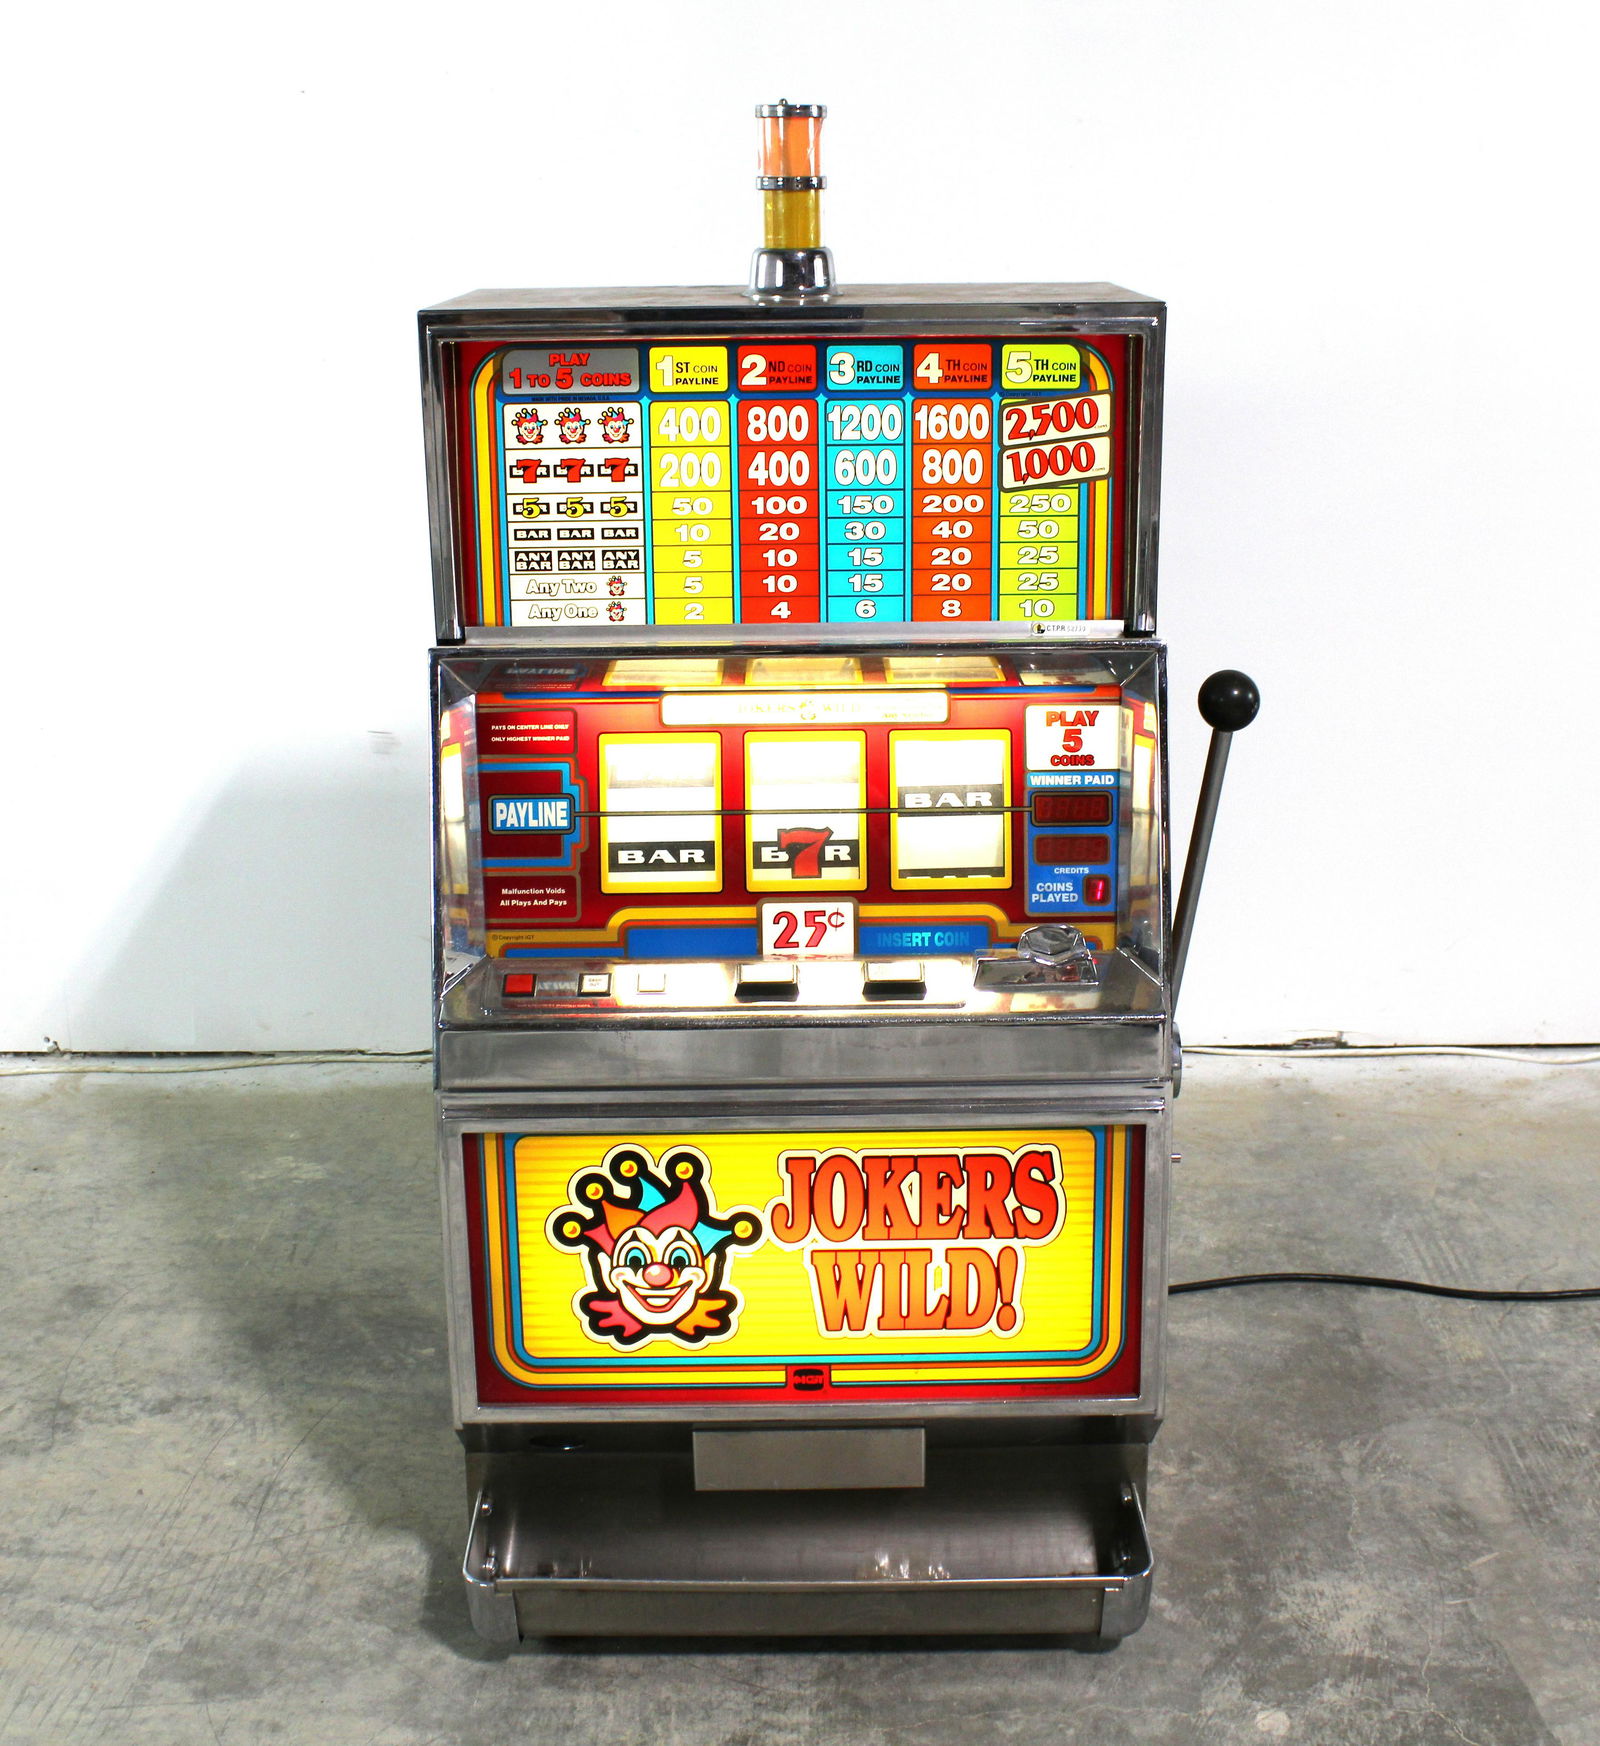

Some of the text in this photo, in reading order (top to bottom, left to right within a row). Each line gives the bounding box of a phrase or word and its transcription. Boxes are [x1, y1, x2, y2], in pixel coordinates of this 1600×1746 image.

[549, 353, 590, 367] PLAY
[875, 363, 900, 372] COIN
[963, 363, 988, 372] COIN
[1051, 362, 1077, 371] COIN
[693, 365, 718, 373] COIN
[787, 364, 813, 373] COIN
[509, 368, 632, 389] 1 TO 5 COINS
[675, 377, 719, 386] PAYLINE
[768, 375, 813, 385] PAYLINE
[856, 374, 901, 384] PAYLINE
[944, 373, 988, 384] PAYLINE
[1032, 373, 1077, 383] PAYLINE
[658, 398, 1100, 443] 400 800 1200 1600 2,500
[659, 441, 1096, 489] 200 400 600 800 1,000
[672, 493, 1072, 515] 50 100 150 200 250
[516, 529, 637, 539] BAR BAR BAR
[675, 520, 1060, 542] 10 20 30 40 50
[516, 551, 638, 561] ANY ANY ANY
[682, 546, 1059, 568] 5 10 15 20 25
[516, 560, 639, 570] BAR BAR BAR
[526, 579, 597, 597] Any Two
[683, 572, 1060, 594] 5 10 15 20 25
[528, 603, 598, 621] Any One
[684, 599, 1055, 621] 2 4 6 8 10
[1046, 710, 1100, 727] PLAY
[1062, 728, 1083, 753] 5
[1050, 754, 1095, 766] COINS
[1030, 774, 1115, 786] WINNER PAID
[905, 792, 993, 808] BAR
[496, 801, 568, 828] PAYLINE
[617, 848, 706, 864] BAR
[777, 826, 834, 879] 7
[502, 887, 544, 895] Malfunction
[1036, 882, 1073, 892] COINS
[511, 899, 532, 907] Plays
[549, 899, 567, 907] Pays
[1032, 893, 1078, 903] PLAYED
[773, 907, 845, 949] 25¢
[877, 931, 970, 947] INSERT COIN
[770, 1153, 1058, 1245] JOKERS
[811, 1245, 1018, 1333] WILD!
